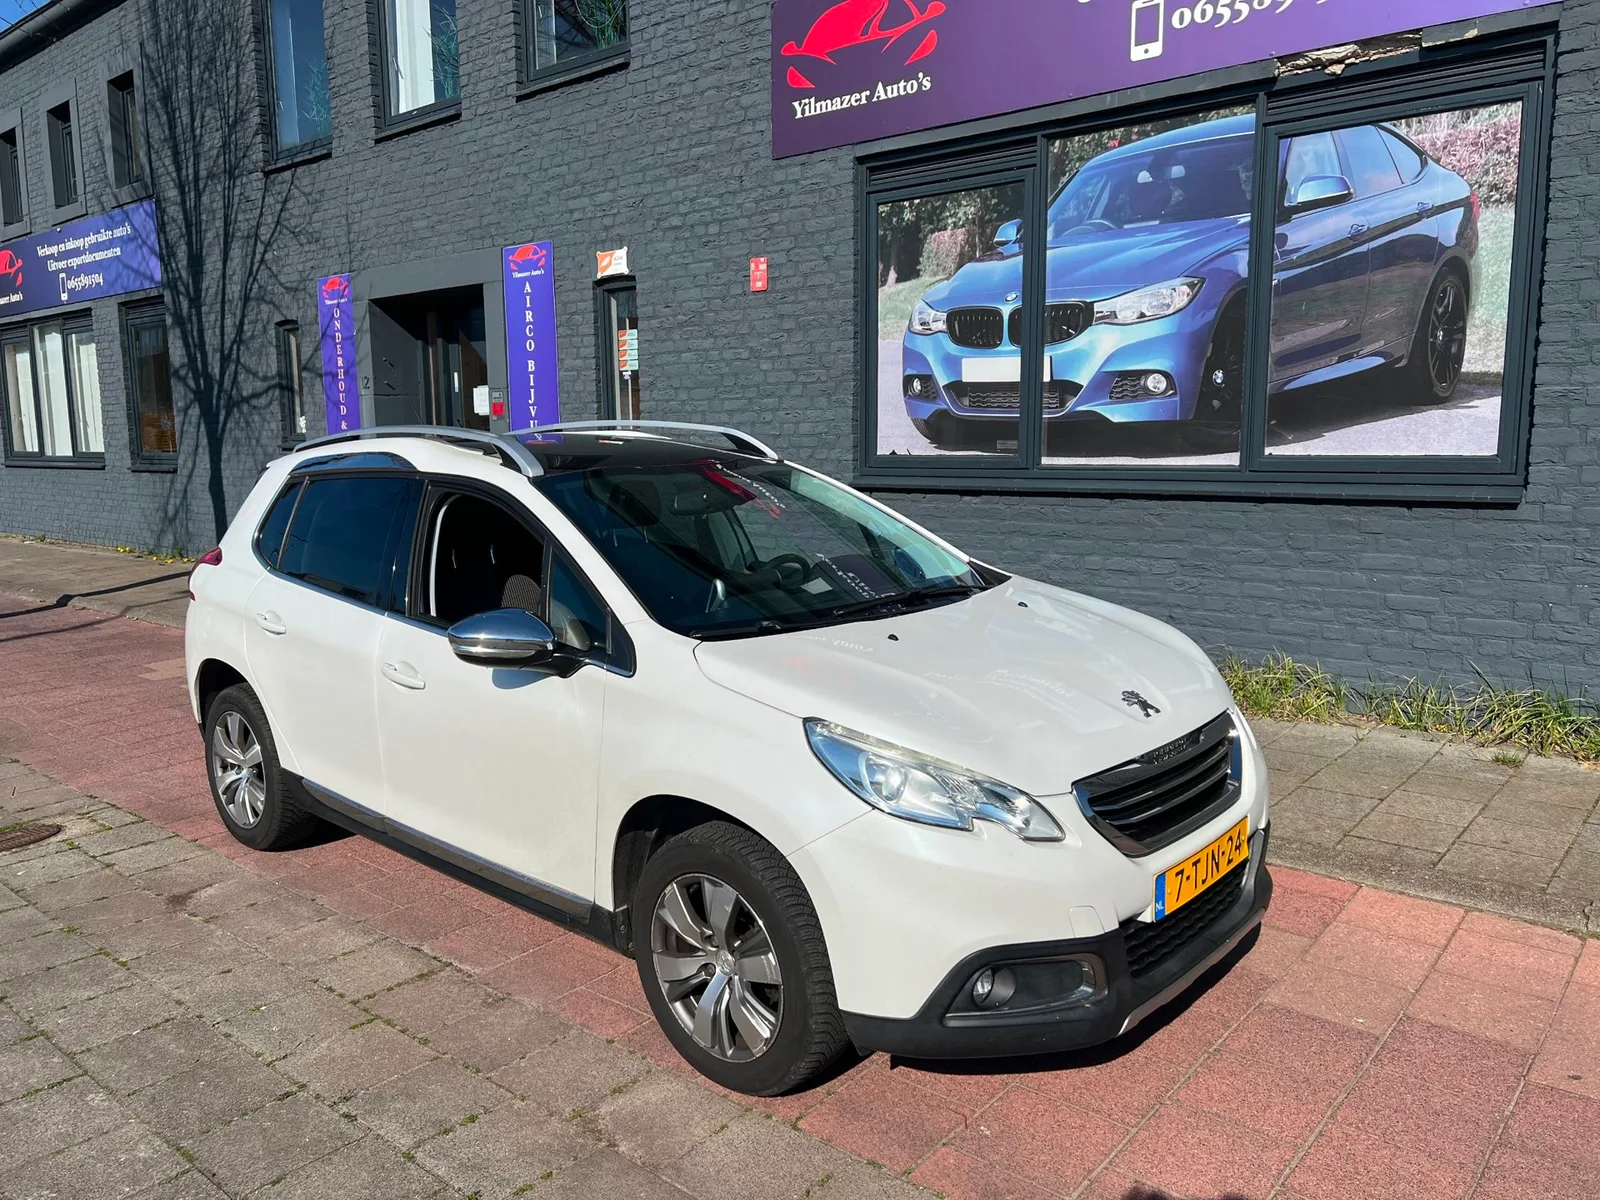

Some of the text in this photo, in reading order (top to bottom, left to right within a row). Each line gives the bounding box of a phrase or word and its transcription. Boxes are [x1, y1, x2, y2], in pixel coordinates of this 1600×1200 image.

[792, 72, 932, 119] Yilmazer Auto's
[65, 237, 84, 251] inkoop
[85, 230, 113, 248] gebruikte
[113, 223, 131, 237] auto's
[47, 246, 121, 271] Uitvoer exportdocumenten
[67, 272, 104, 291] 0655891504
[523, 281, 535, 351] AIRCO
[333, 308, 348, 430] ONDERHOUD &
[1175, 828, 1242, 903] 7-TJN-24
[1155, 900, 1165, 912] NL
